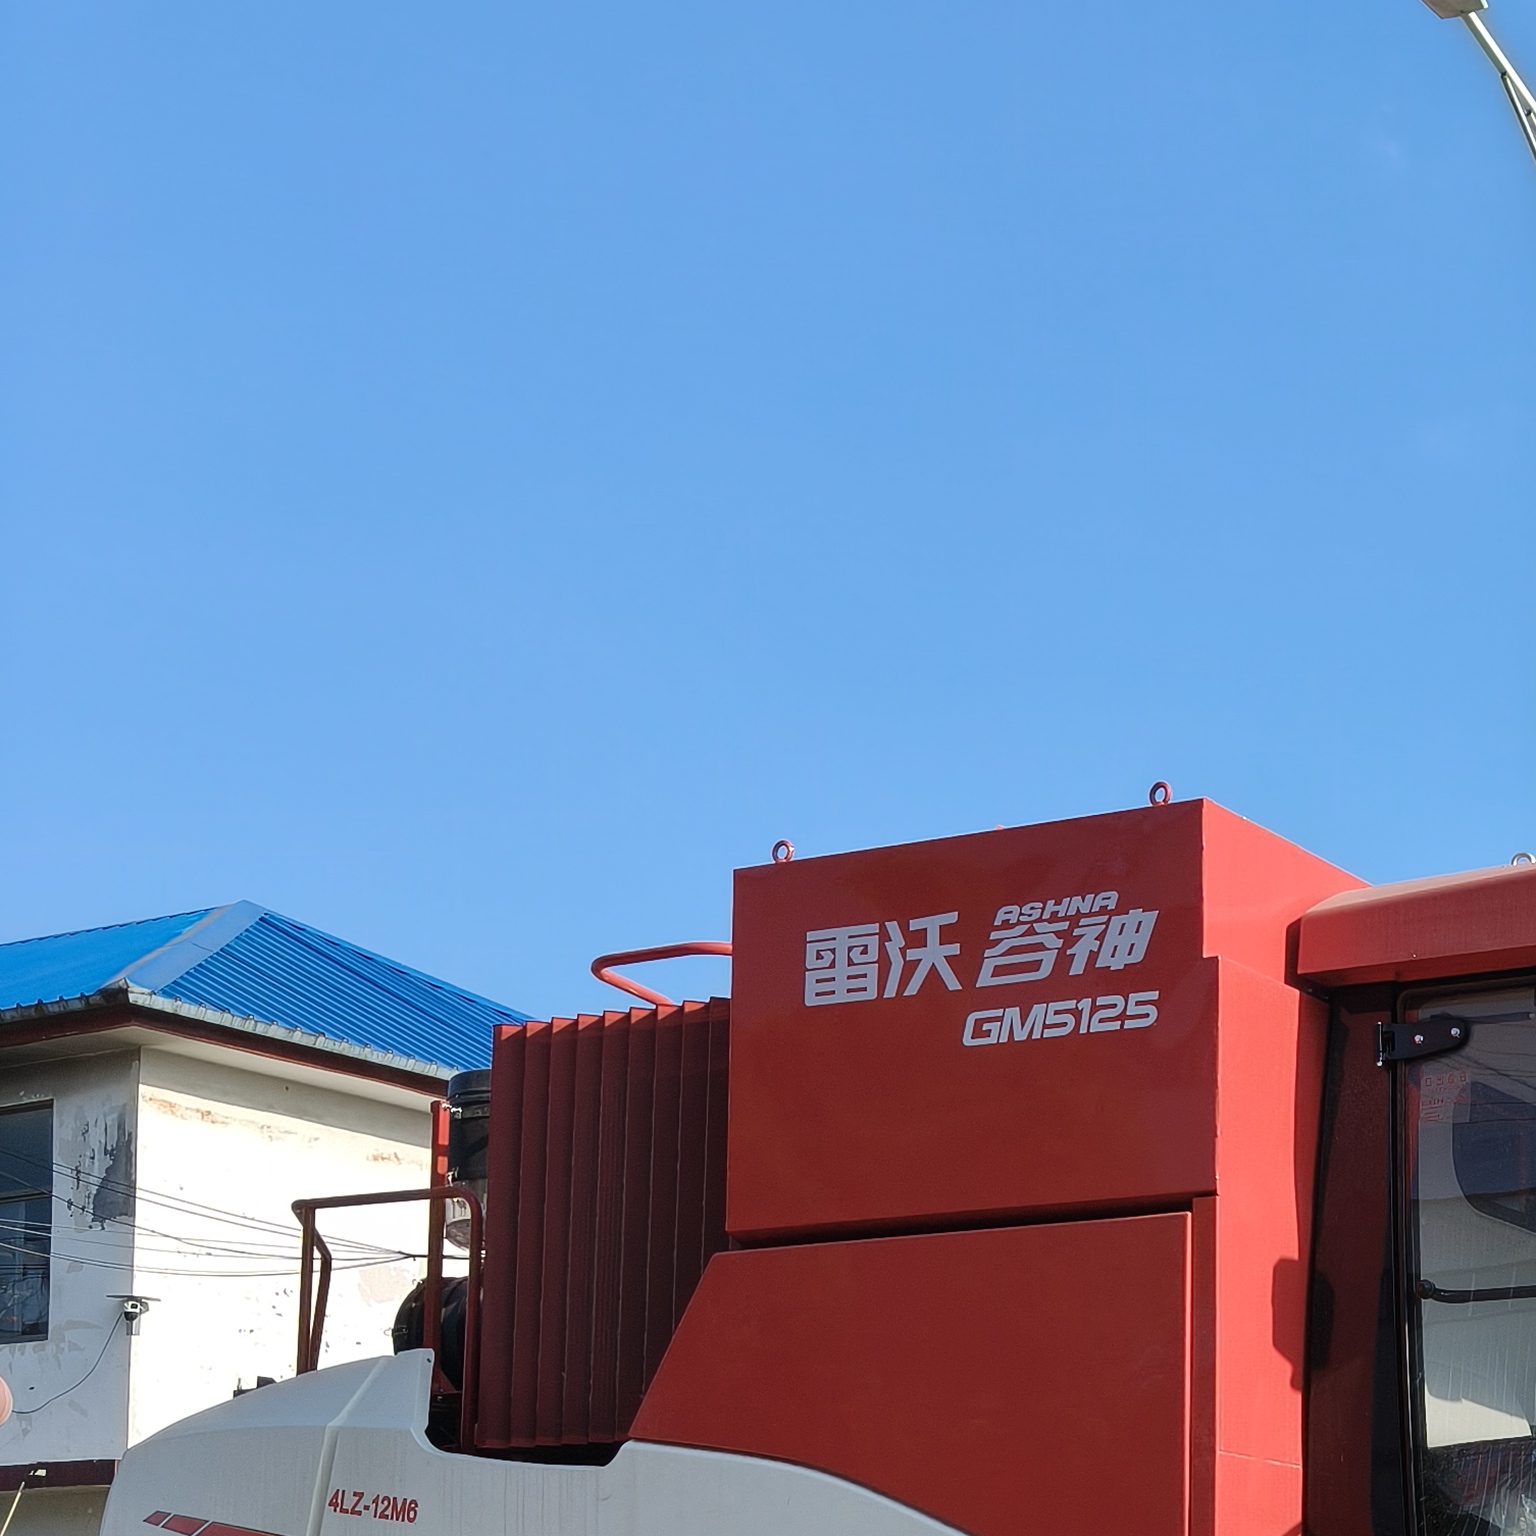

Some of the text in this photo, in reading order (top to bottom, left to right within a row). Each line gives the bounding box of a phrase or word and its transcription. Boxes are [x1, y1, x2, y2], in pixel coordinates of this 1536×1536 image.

[994, 891, 1119, 926] ASHNA
[804, 908, 1160, 1007] 雷沃 谷神
[962, 990, 1160, 1046] GM5125
[328, 1489, 419, 1523] 4LZ-12M6
